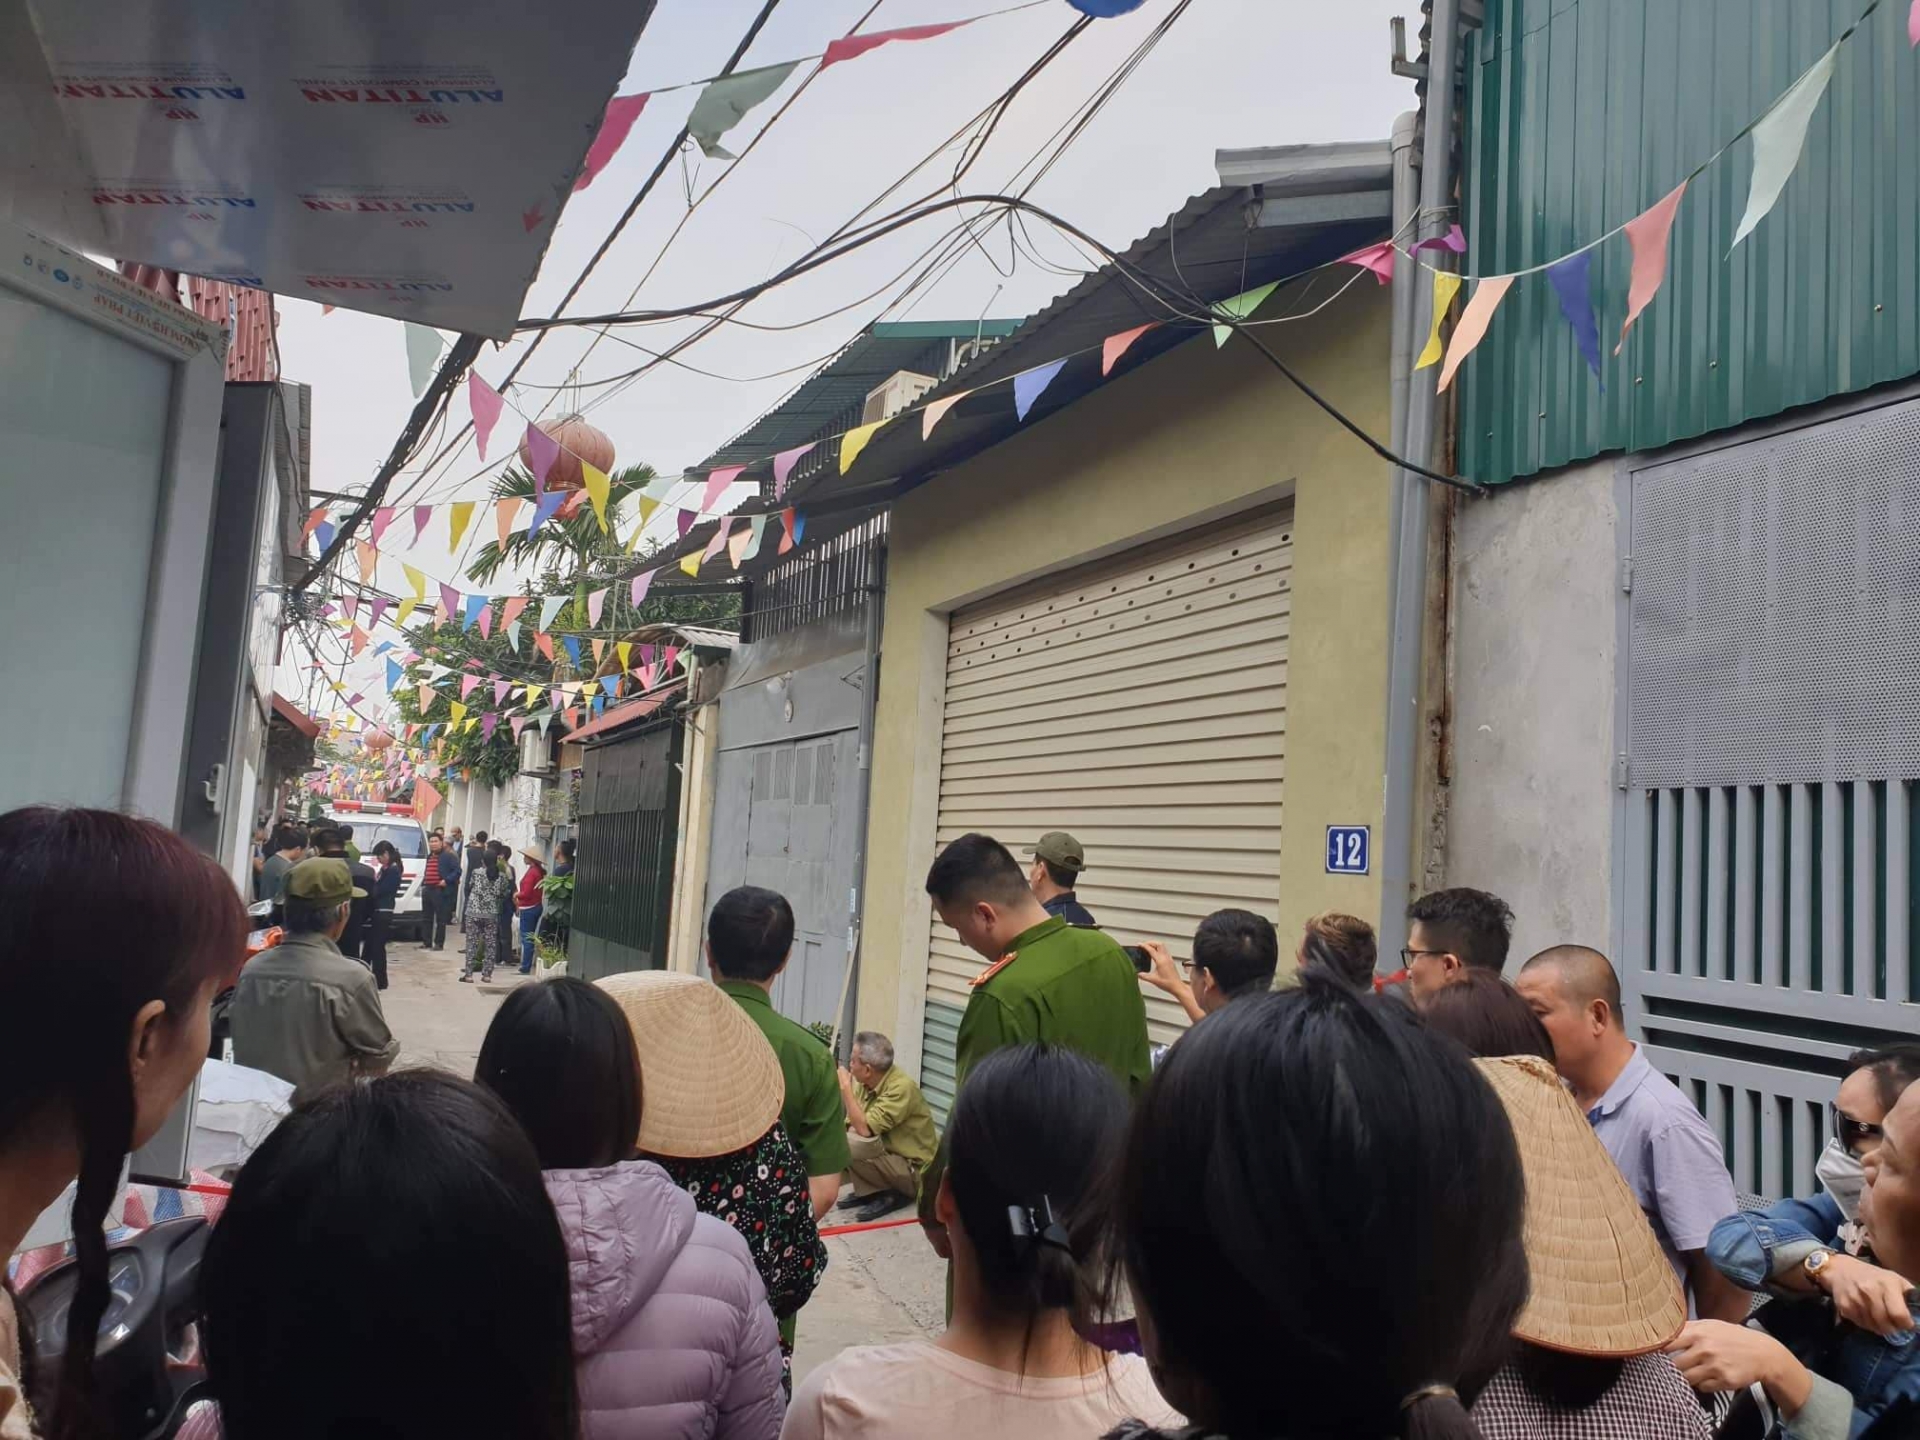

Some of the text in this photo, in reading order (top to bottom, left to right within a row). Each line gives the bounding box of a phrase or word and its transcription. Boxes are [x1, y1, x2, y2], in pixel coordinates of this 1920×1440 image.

[301, 89, 503, 103] ALUTITAN
[414, 113, 449, 123] HP
[92, 194, 256, 207] ALUTITAN
[303, 200, 474, 212] ALUTITAN
[306, 280, 453, 291] ALUTITAN
[1335, 833, 1361, 866] 12
